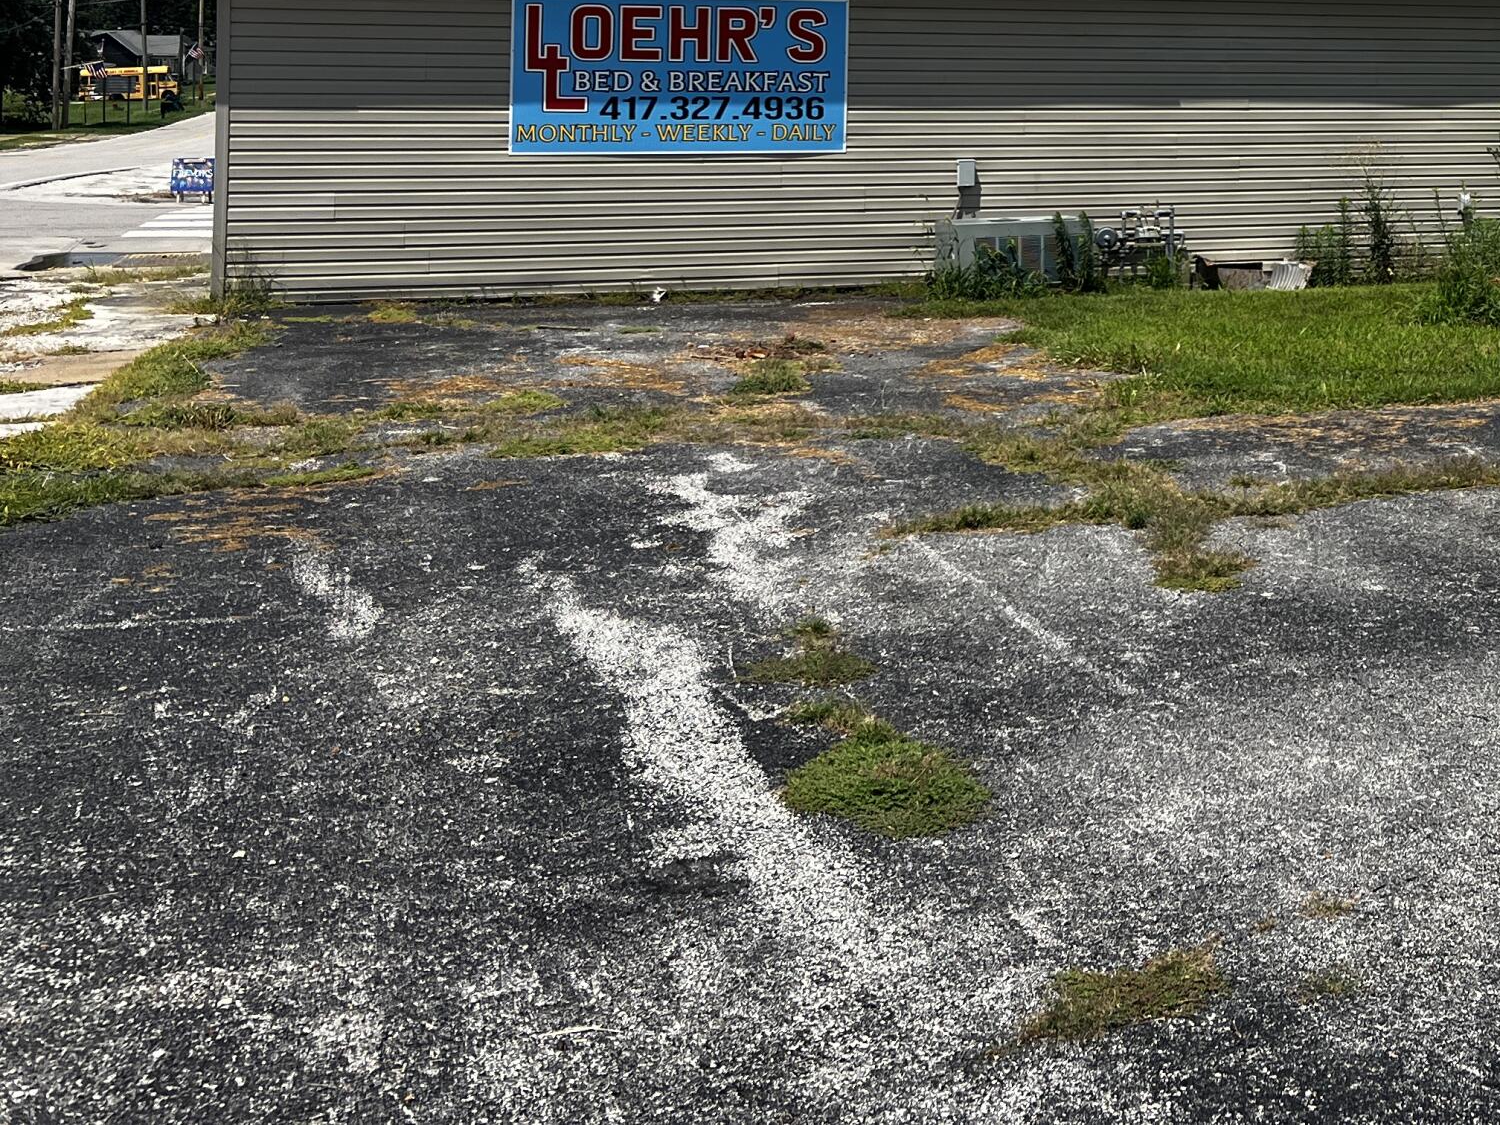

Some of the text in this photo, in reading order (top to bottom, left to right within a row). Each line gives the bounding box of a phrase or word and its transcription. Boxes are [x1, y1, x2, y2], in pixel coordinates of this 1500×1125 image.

[574, 70, 830, 93] BED & BREAKFAST
[599, 95, 825, 121] 417.327.4936
[515, 124, 637, 143] MONTHLY
[656, 124, 752, 142] WEEKLY
[770, 123, 837, 142] DAILY
